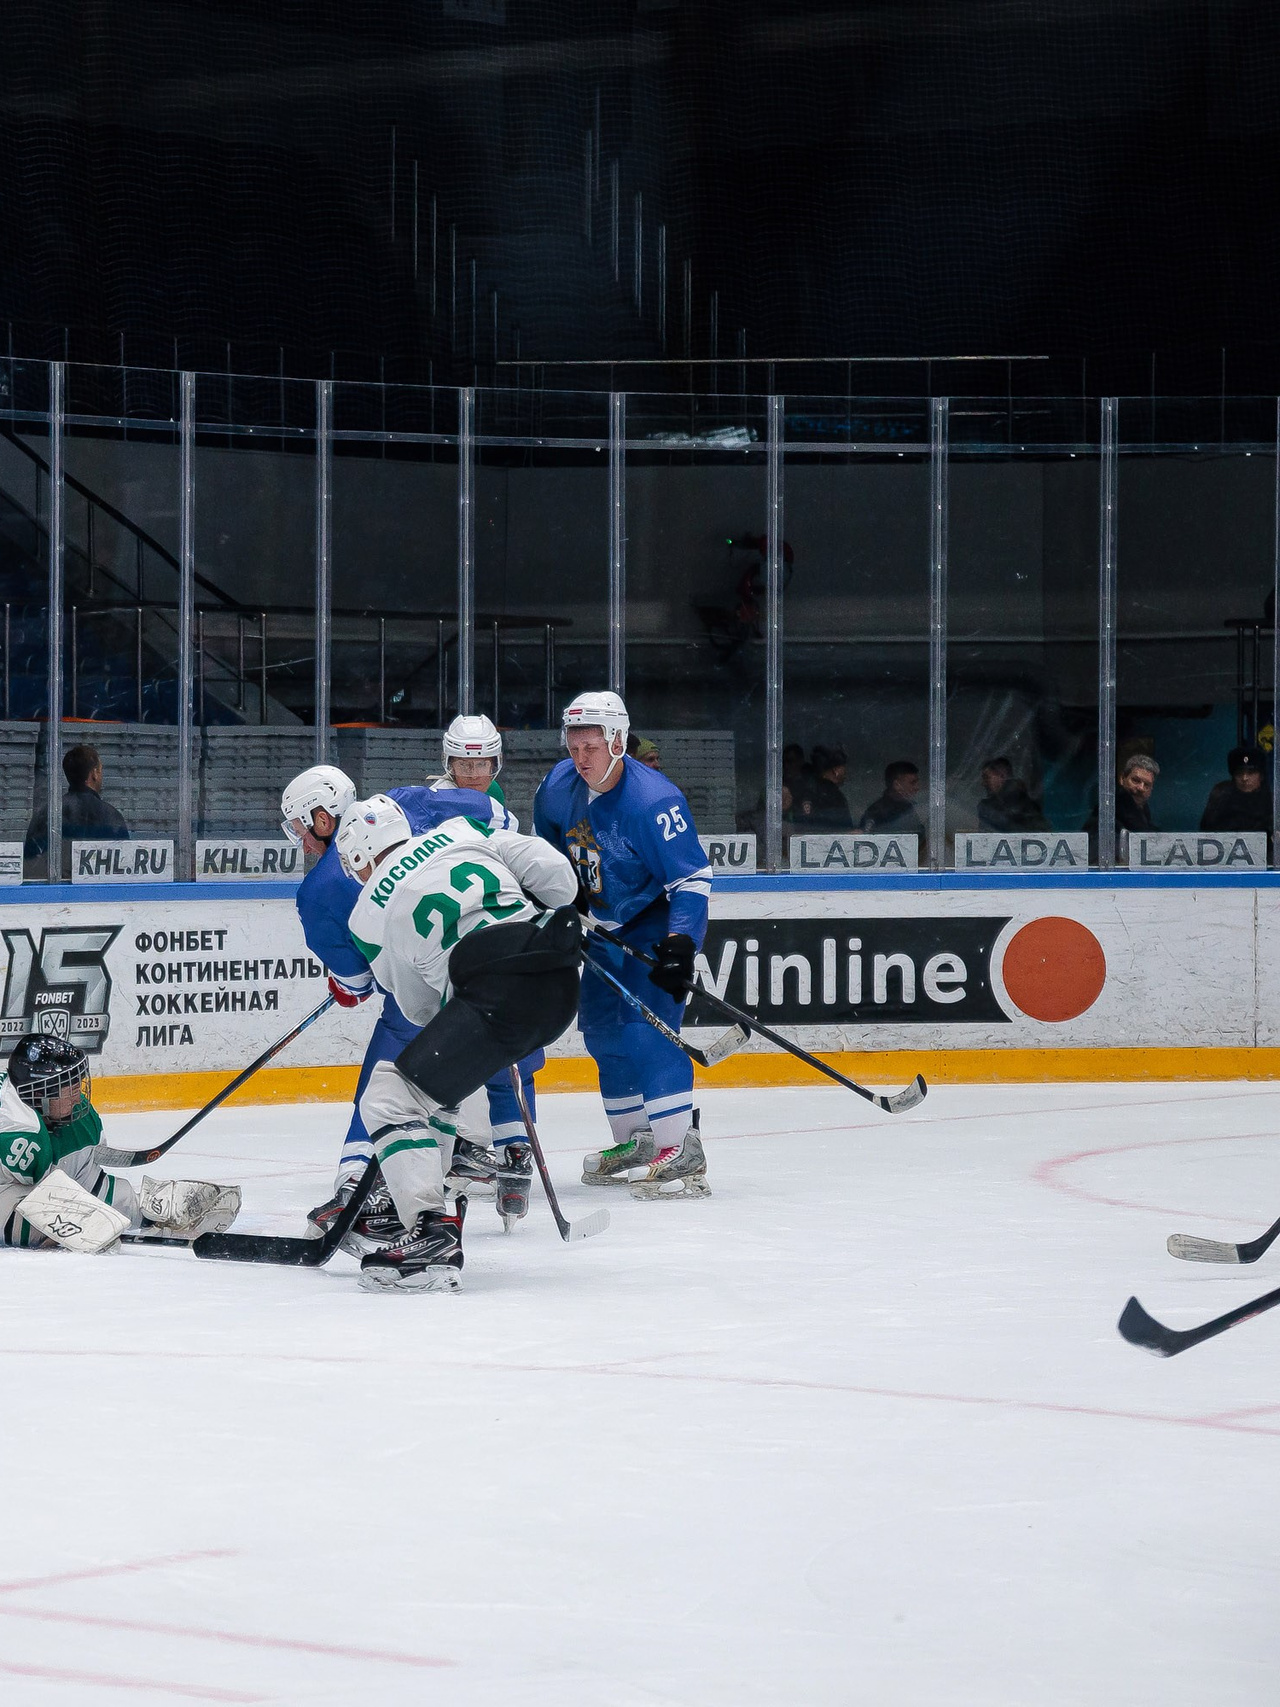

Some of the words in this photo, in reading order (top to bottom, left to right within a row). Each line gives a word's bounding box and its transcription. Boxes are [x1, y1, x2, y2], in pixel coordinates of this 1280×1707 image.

[656, 805, 688, 842] 25
[78, 848, 168, 876] KHL.RU
[202, 847, 298, 874] KHL.RU
[800, 840, 908, 869] LADA
[965, 838, 1077, 867] LADA
[1139, 837, 1256, 867] LADA
[370, 833, 455, 909] КОСОЛАП
[412, 861, 527, 951] 22
[135, 929, 228, 953] ФОНБЕТ
[135, 958, 329, 985] КОНТИНЕНТАЛЬ
[686, 936, 968, 1006] Winline
[35, 991, 75, 1005] FONBET
[135, 986, 280, 1016] ХОККЕЙНАЯ
[1, 1021, 24, 1033] 2022
[77, 1017, 100, 1029] 2023
[135, 1024, 195, 1048] ЛИГА
[5, 1137, 42, 1172] 95
[365, 1217, 389, 1225] CCM
